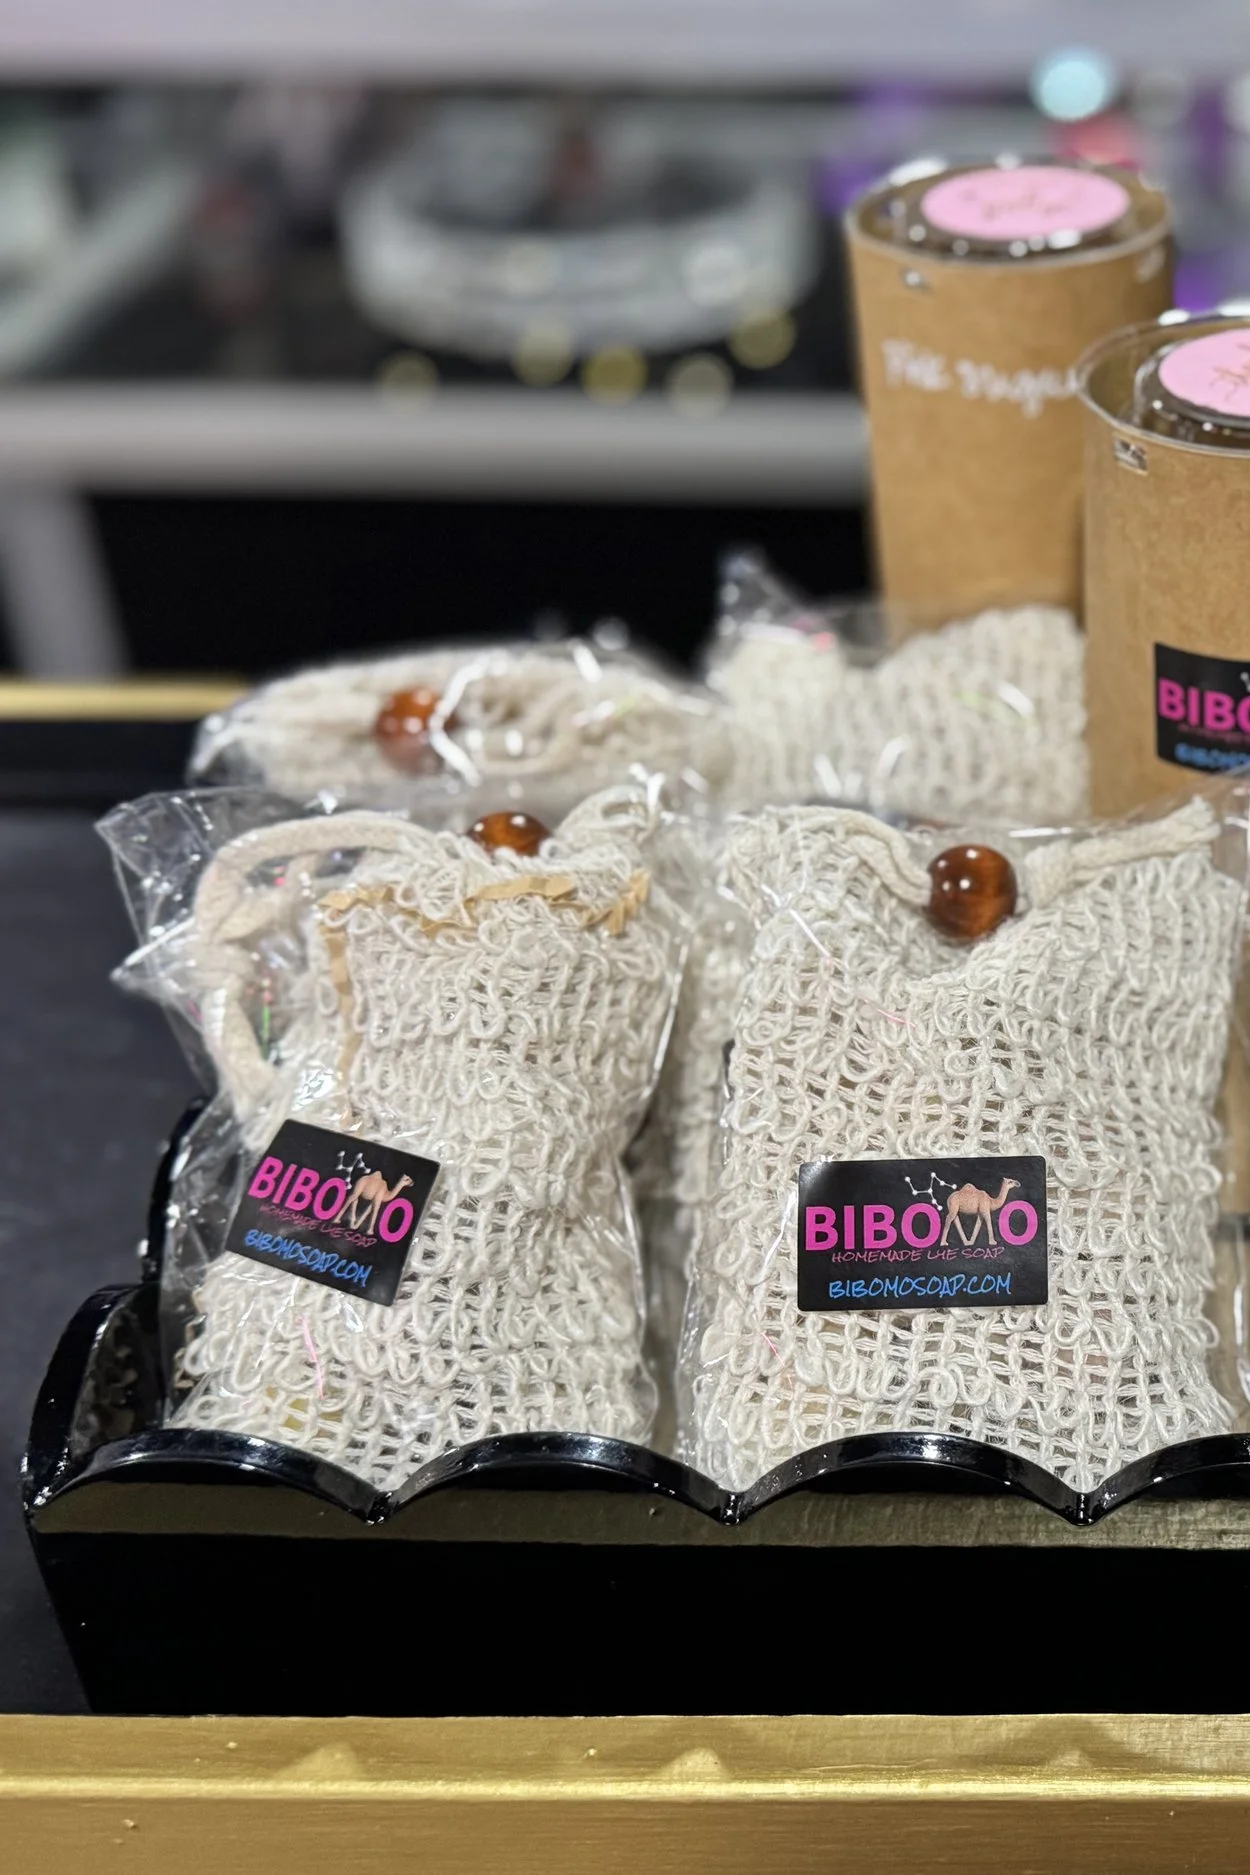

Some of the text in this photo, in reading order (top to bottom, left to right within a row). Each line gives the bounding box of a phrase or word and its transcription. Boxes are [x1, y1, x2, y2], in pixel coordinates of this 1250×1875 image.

[247, 1156, 414, 1243] BIBOMO
[805, 1200, 1039, 1251] BIBOMO
[243, 1229, 373, 1288] BIBOMOSOAP.COM
[831, 1246, 1006, 1263] HOMEMADE LYE SOAP
[828, 1272, 1012, 1299] BIBOMOSOAP.COM
